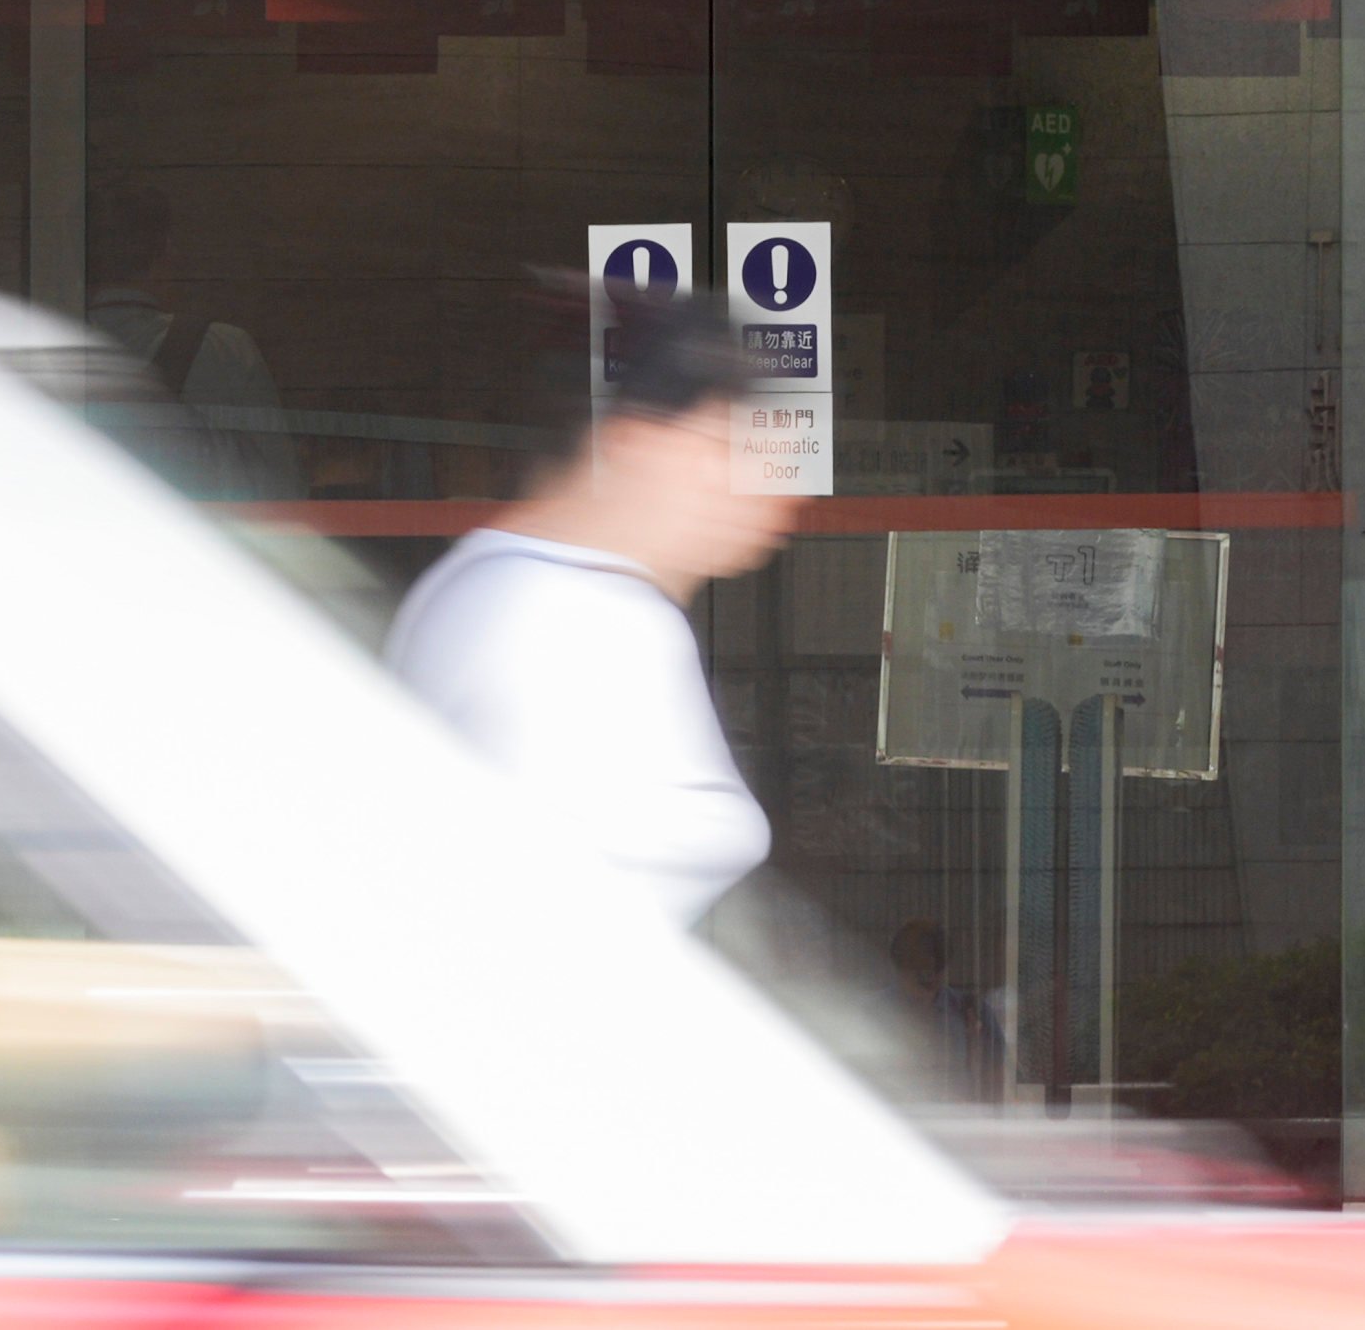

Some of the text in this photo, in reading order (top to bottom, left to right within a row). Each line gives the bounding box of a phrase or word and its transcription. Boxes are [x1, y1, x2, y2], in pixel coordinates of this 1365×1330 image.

[1032, 113, 1072, 135] AED
[747, 330, 813, 350] 請勿靠近
[780, 354, 813, 369] Clear
[752, 408, 814, 429] 自動門
[743, 436, 820, 455] Automatic
[763, 461, 800, 479] Door
[1045, 545, 1096, 586] T1
